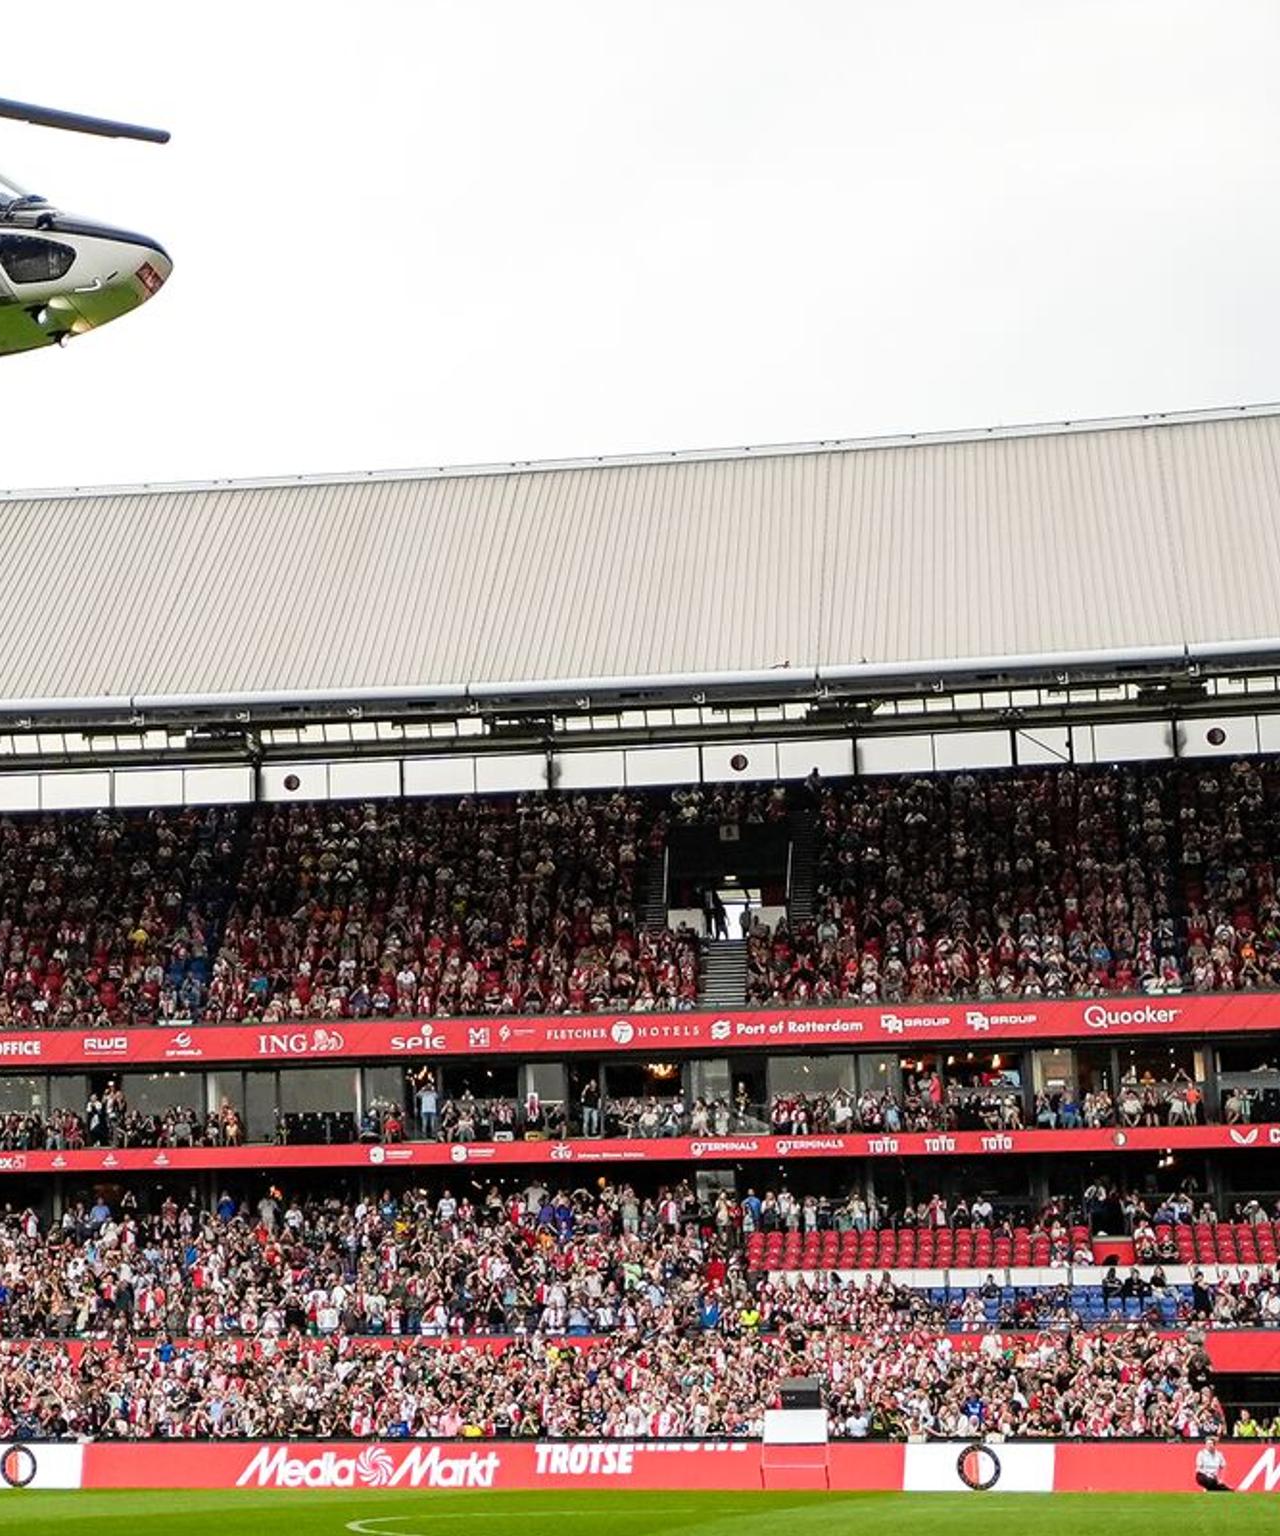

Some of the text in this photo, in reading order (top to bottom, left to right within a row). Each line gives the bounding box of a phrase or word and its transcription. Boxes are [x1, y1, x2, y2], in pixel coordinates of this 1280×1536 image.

[1084, 1005, 1178, 1028] Quooker
[546, 1028, 607, 1040] FLETCHER
[637, 1025, 700, 1037] HOTELS
[736, 1018, 863, 1034] Port of Rotterdam
[258, 1034, 308, 1053] ING
[867, 1136, 899, 1153] TOTO
[924, 1134, 956, 1151] TOTO
[981, 1133, 1013, 1150] TOTO
[535, 1444, 634, 1474] TROTSE
